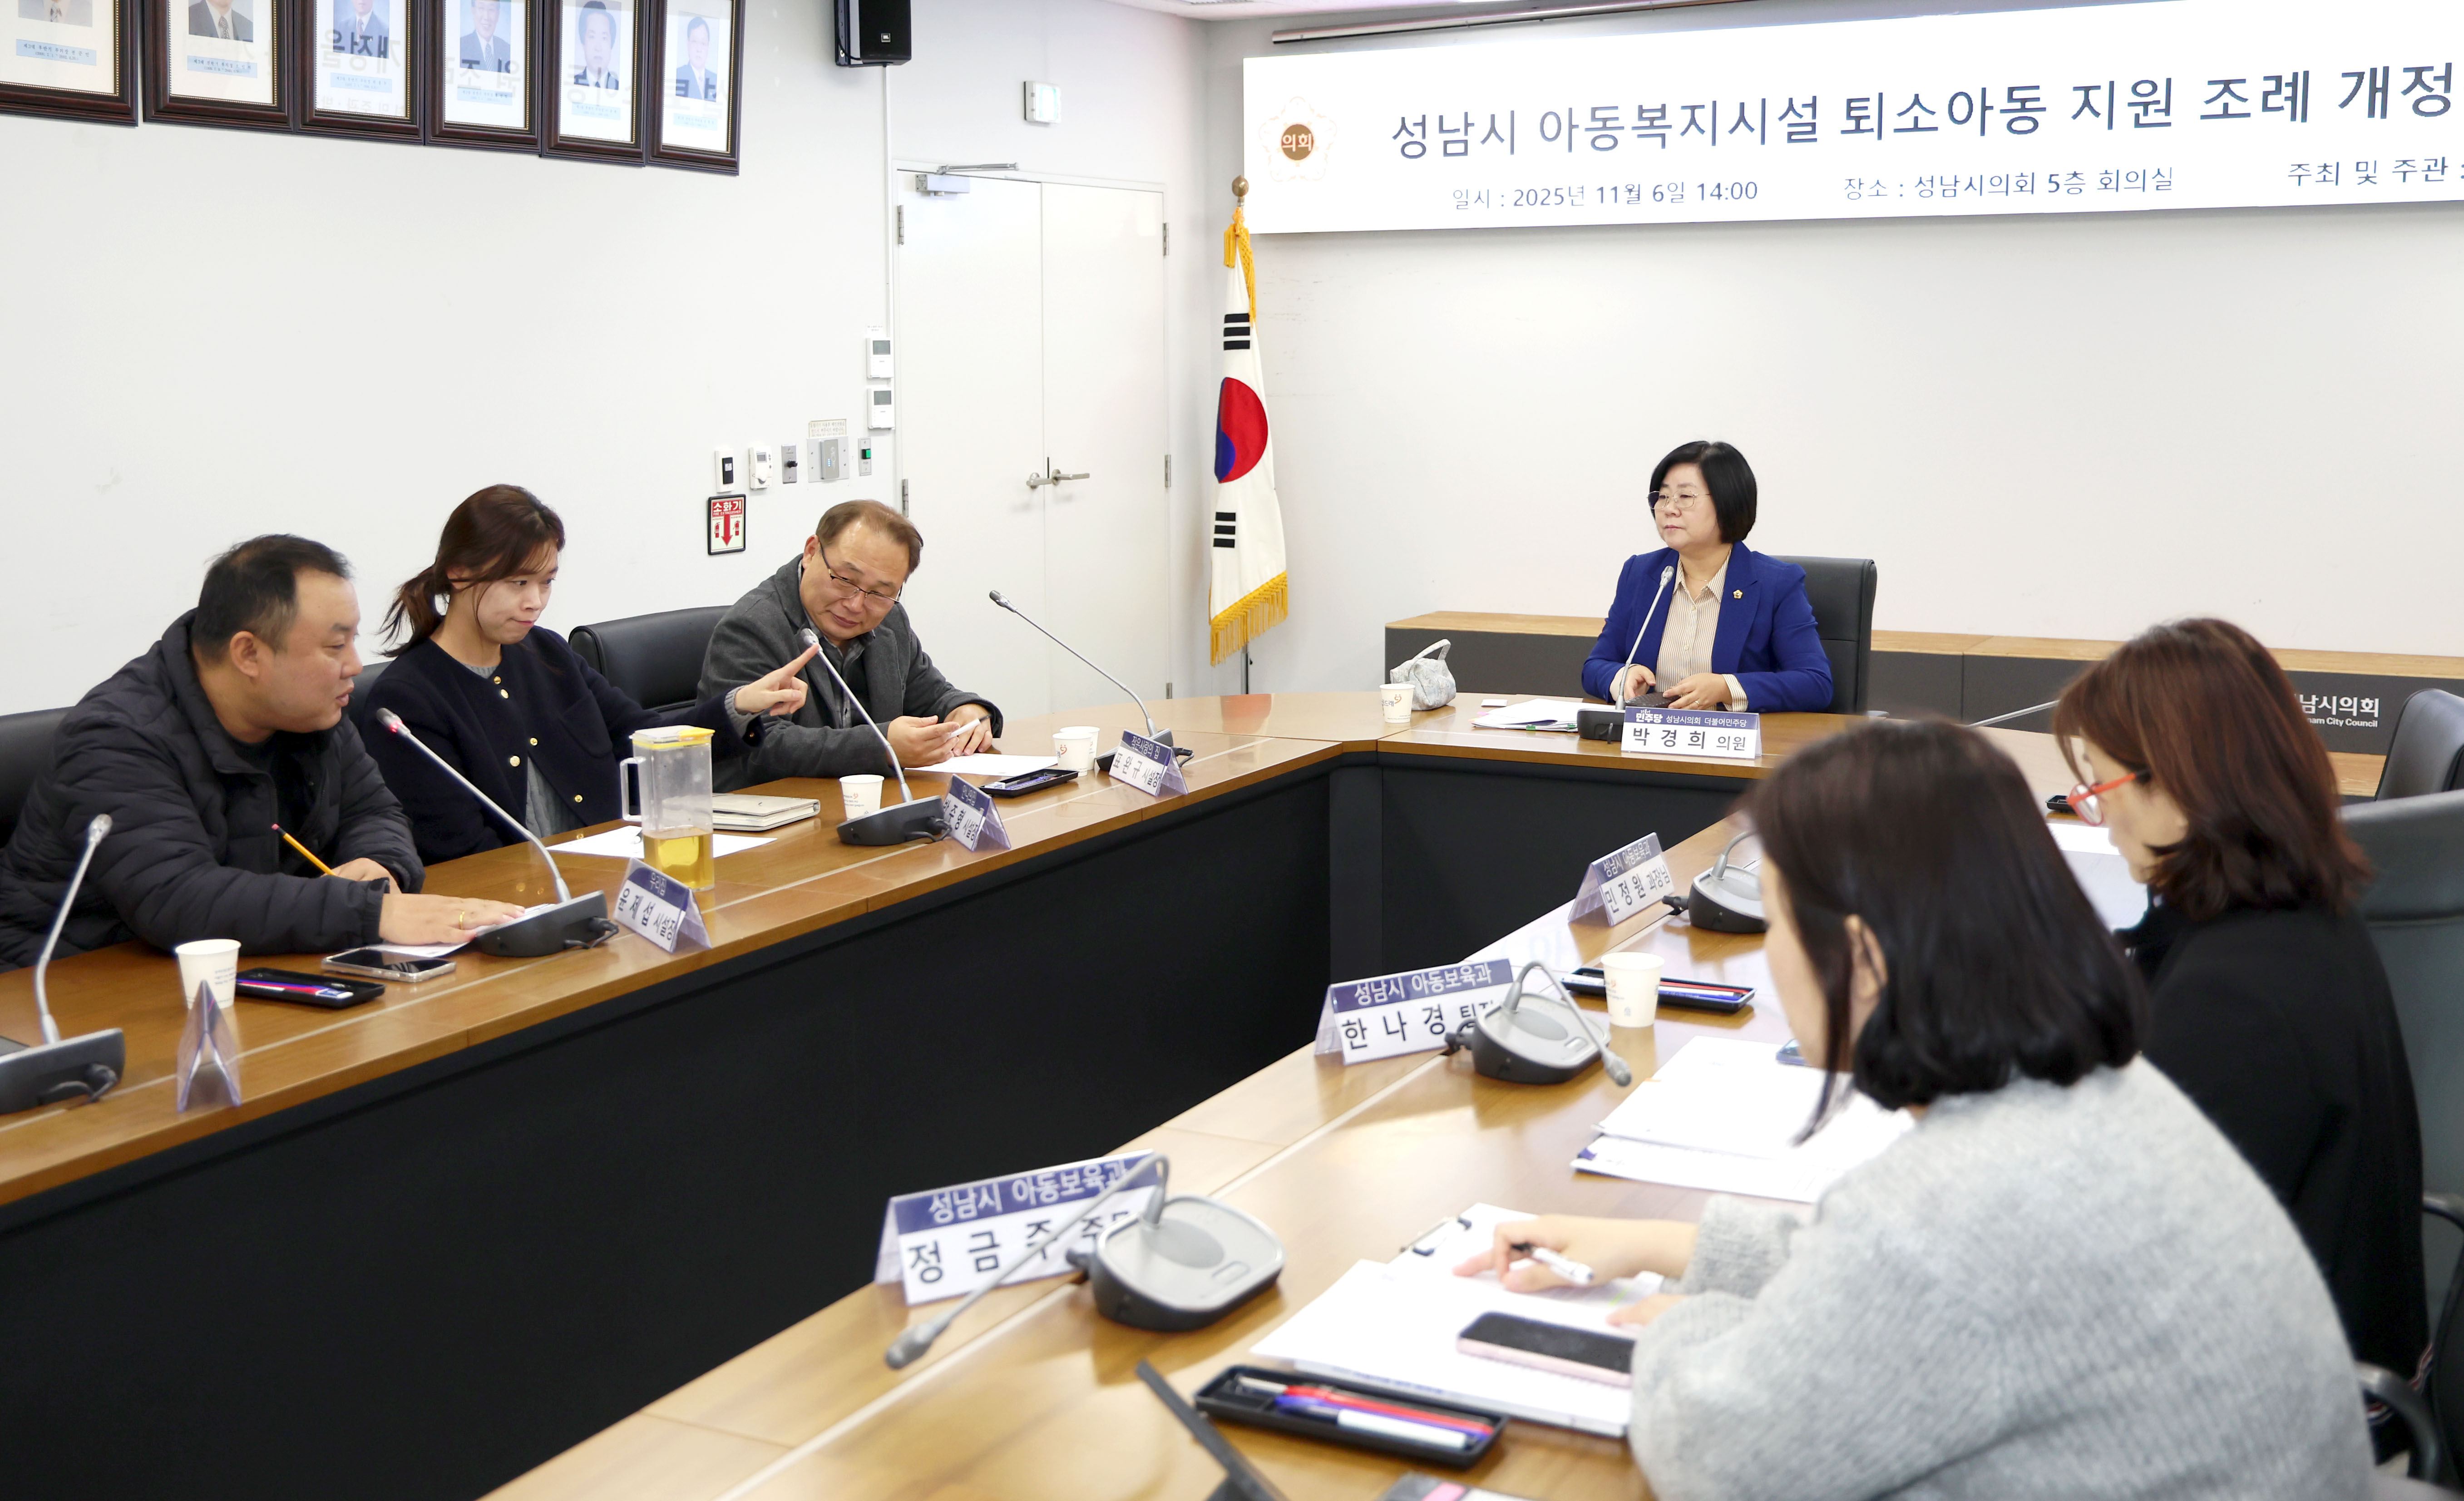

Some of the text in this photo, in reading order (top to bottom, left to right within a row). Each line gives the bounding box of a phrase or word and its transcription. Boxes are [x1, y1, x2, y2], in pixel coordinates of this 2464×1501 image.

[1392, 62, 2453, 160] 성남시 아동복지시설 퇴소아동 지원 조례 개정
[1282, 133, 1312, 152] 의회
[1452, 188, 1490, 210] 일시
[1513, 185, 1584, 207] 2025년
[1596, 183, 1641, 205] 11월
[1652, 181, 1685, 204] 6일
[1697, 181, 1758, 201] 14:00
[1844, 176, 1888, 201] 장소
[1914, 171, 2035, 198] 성남시의회
[2048, 170, 2086, 195] 5층
[2096, 166, 2174, 193] 회의실
[2287, 161, 2340, 187] 주최
[2355, 159, 2378, 186] 및
[2391, 155, 2449, 183] 주관
[713, 500, 741, 513] 소화기
[2294, 693, 2380, 718] 남시의회
[1635, 712, 1748, 727] 민주당 성남시의회 더불어민주당
[2326, 718, 2344, 727] City
[2345, 718, 2378, 728] Council
[1131, 736, 1160, 759] 작은사랑의 집
[1716, 736, 1746, 751] 의원
[1142, 767, 1161, 788] 시설장
[963, 817, 979, 841] 시설장
[1603, 839, 1652, 878] 성남시 아동보육과
[1645, 864, 1670, 891] 과장님
[653, 912, 676, 941] 시설장
[1354, 962, 1493, 1006] 성남시 아동보육과
[928, 1160, 1131, 1224] 성남시 아동보육과
